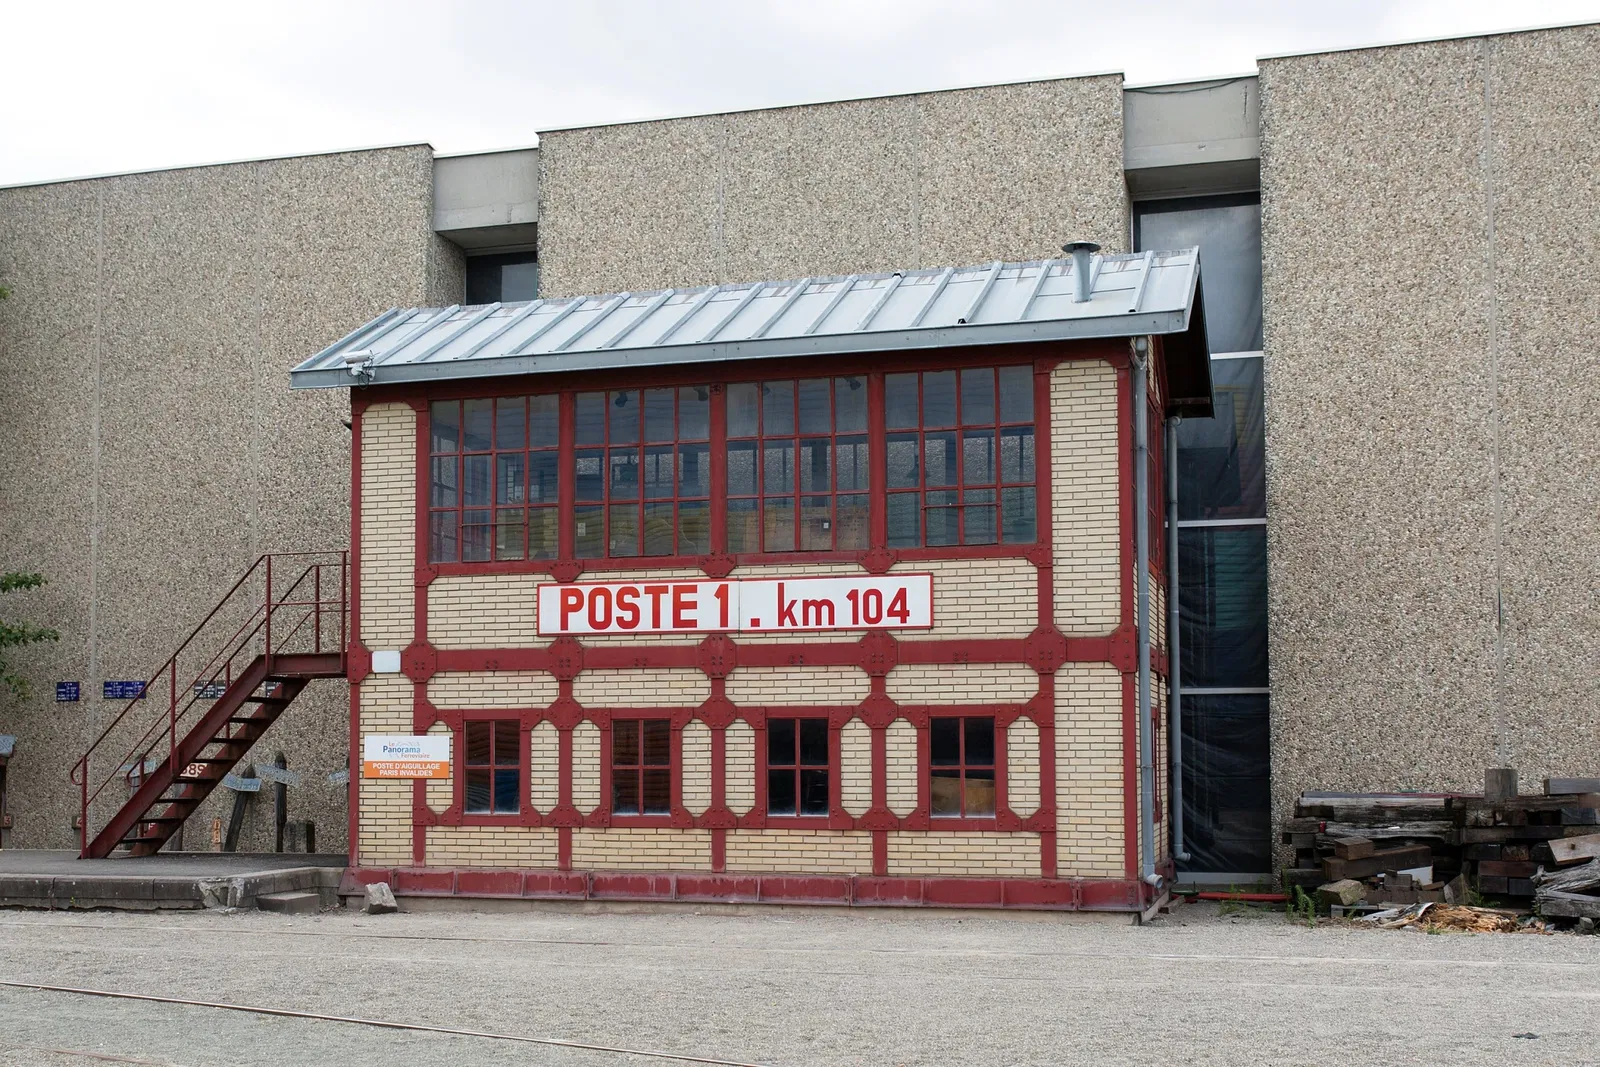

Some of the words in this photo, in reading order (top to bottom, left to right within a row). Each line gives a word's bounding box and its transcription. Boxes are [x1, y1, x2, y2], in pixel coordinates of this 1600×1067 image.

[559, 584, 698, 631] POSTE
[713, 583, 729, 628] 1
[777, 582, 836, 627] km
[846, 586, 910, 626] 104
[382, 745, 421, 753] Panorama
